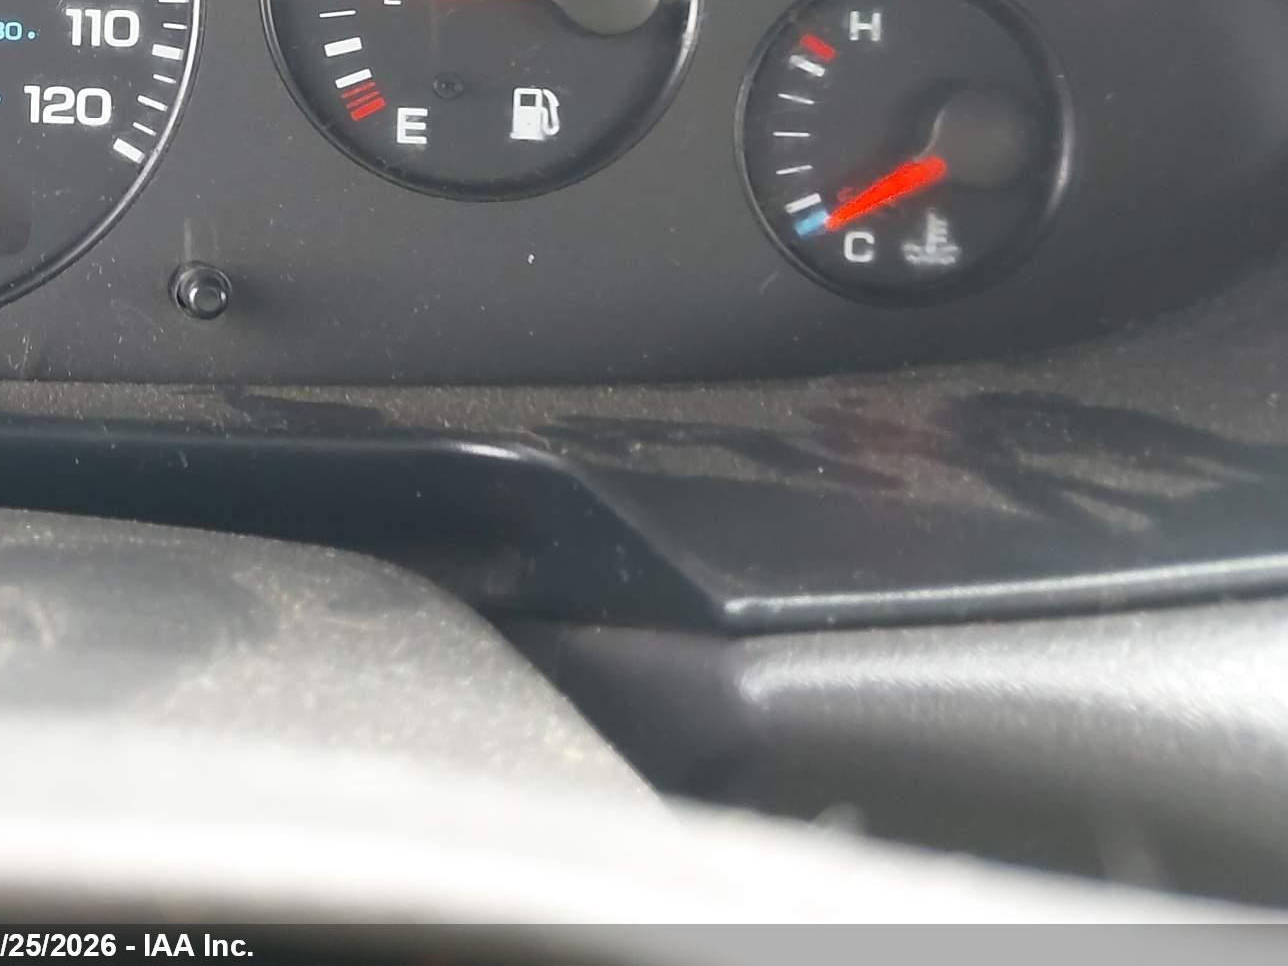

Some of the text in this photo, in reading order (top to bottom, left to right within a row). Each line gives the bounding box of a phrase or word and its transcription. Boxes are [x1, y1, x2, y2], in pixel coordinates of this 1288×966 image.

[66, 8, 139, 47] 110
[849, 10, 881, 42] H
[24, 85, 112, 125] 120
[396, 109, 427, 145] E
[844, 233, 875, 263] C
